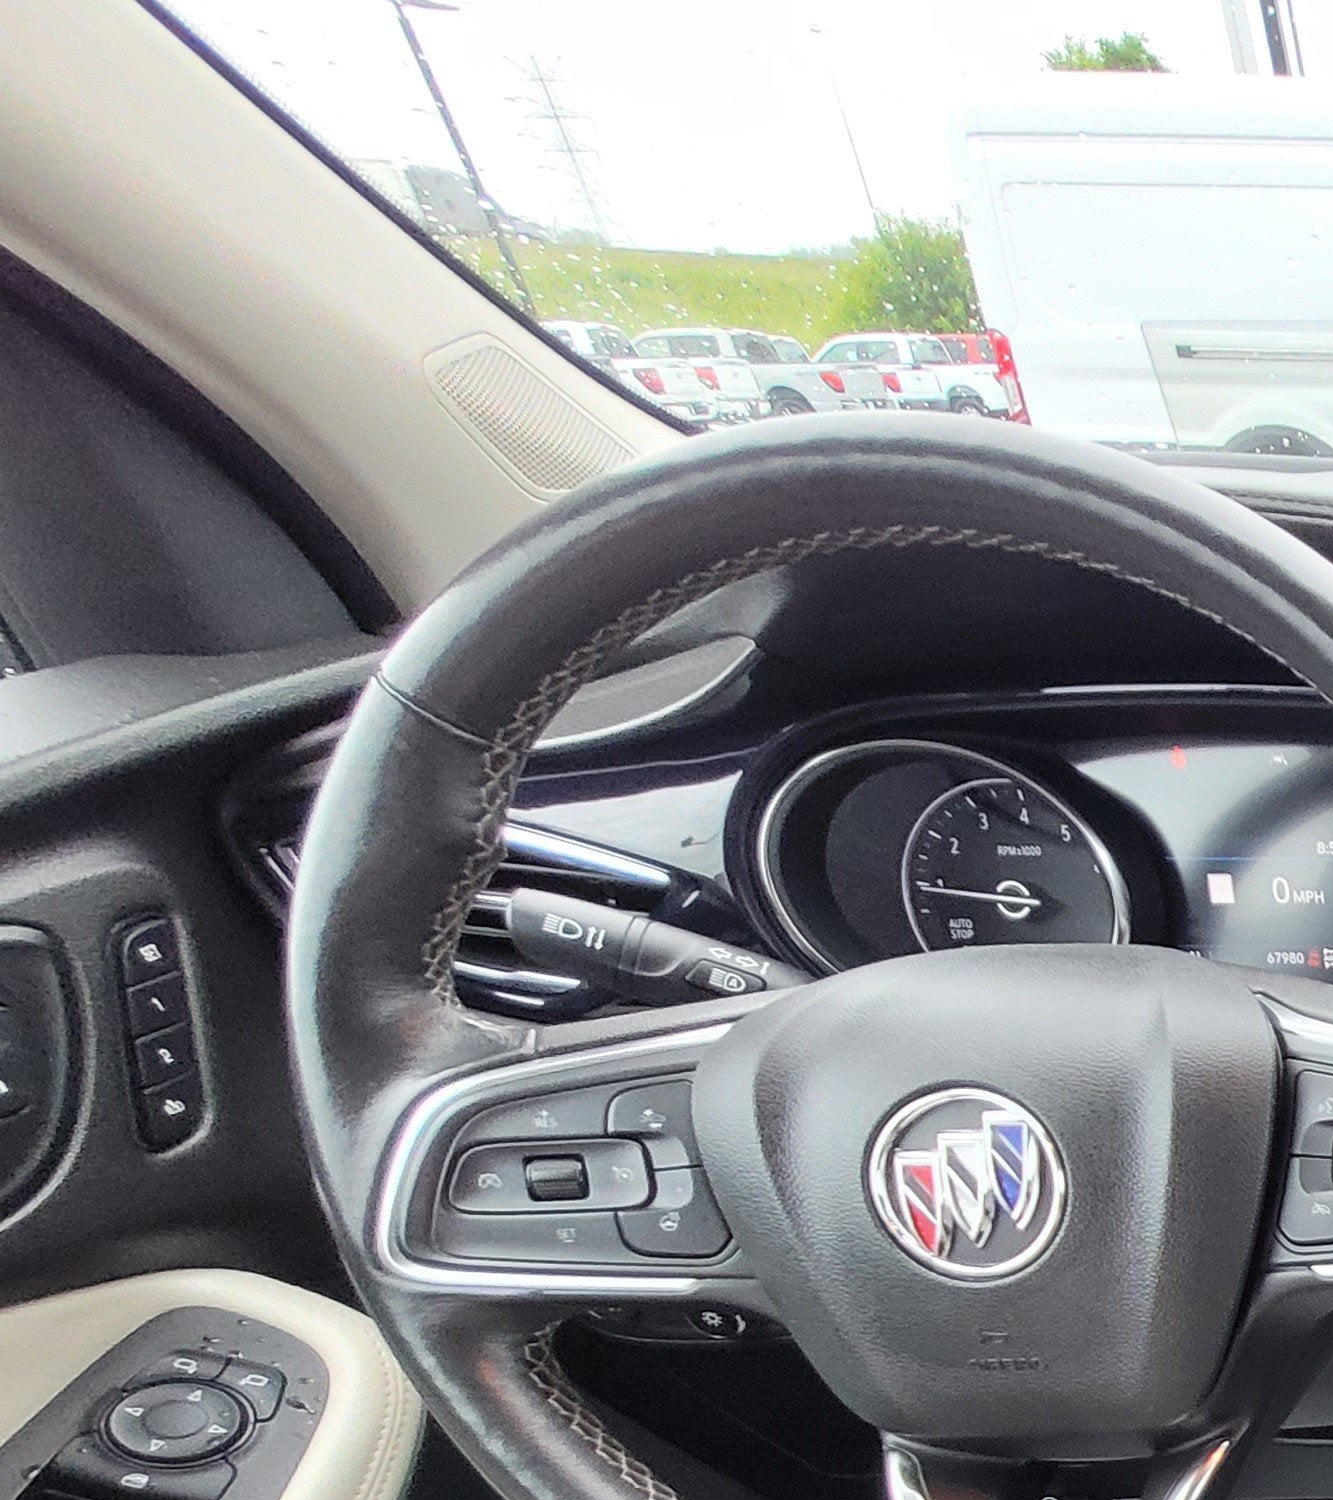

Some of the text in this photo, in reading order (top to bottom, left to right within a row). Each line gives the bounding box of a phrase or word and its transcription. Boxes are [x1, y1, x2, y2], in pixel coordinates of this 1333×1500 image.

[978, 813, 989, 830] 3
[1019, 807, 1030, 825] 4
[1060, 824, 1071, 842] 5
[949, 837, 961, 855] 2
[1272, 876, 1325, 904] 0 MPH
[949, 918, 973, 929] AUTO
[950, 929, 975, 939] STOP
[1266, 952, 1305, 965] 67980
[556, 1228, 577, 1240] SET
